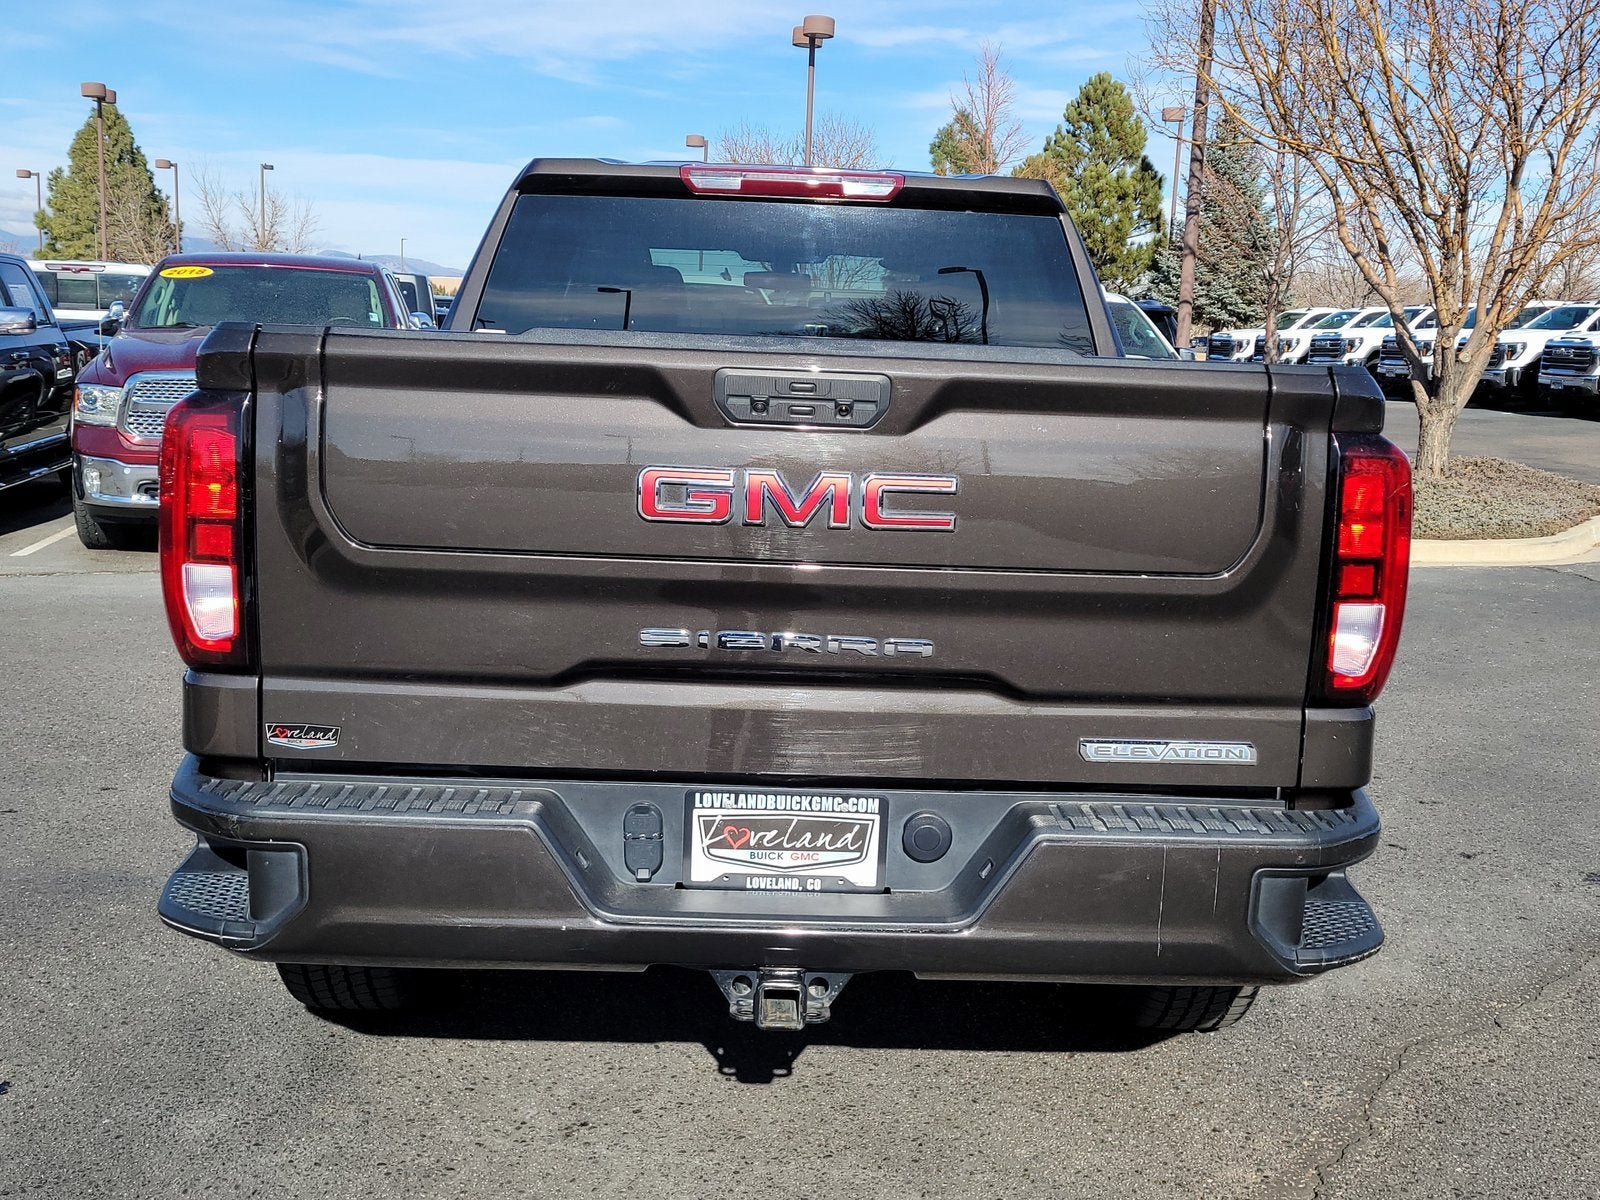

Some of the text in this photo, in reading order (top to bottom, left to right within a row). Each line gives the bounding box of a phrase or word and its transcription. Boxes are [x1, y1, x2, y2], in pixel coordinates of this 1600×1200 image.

[637, 465, 958, 532] GMC
[639, 627, 934, 658] SIERRA
[1093, 745, 1244, 760] ELEVATION
[694, 792, 880, 813] LOVELANDBUICKGMC.COM
[749, 850, 820, 862] BUICK GMC
[746, 876, 822, 891] LOVELAND, CO
